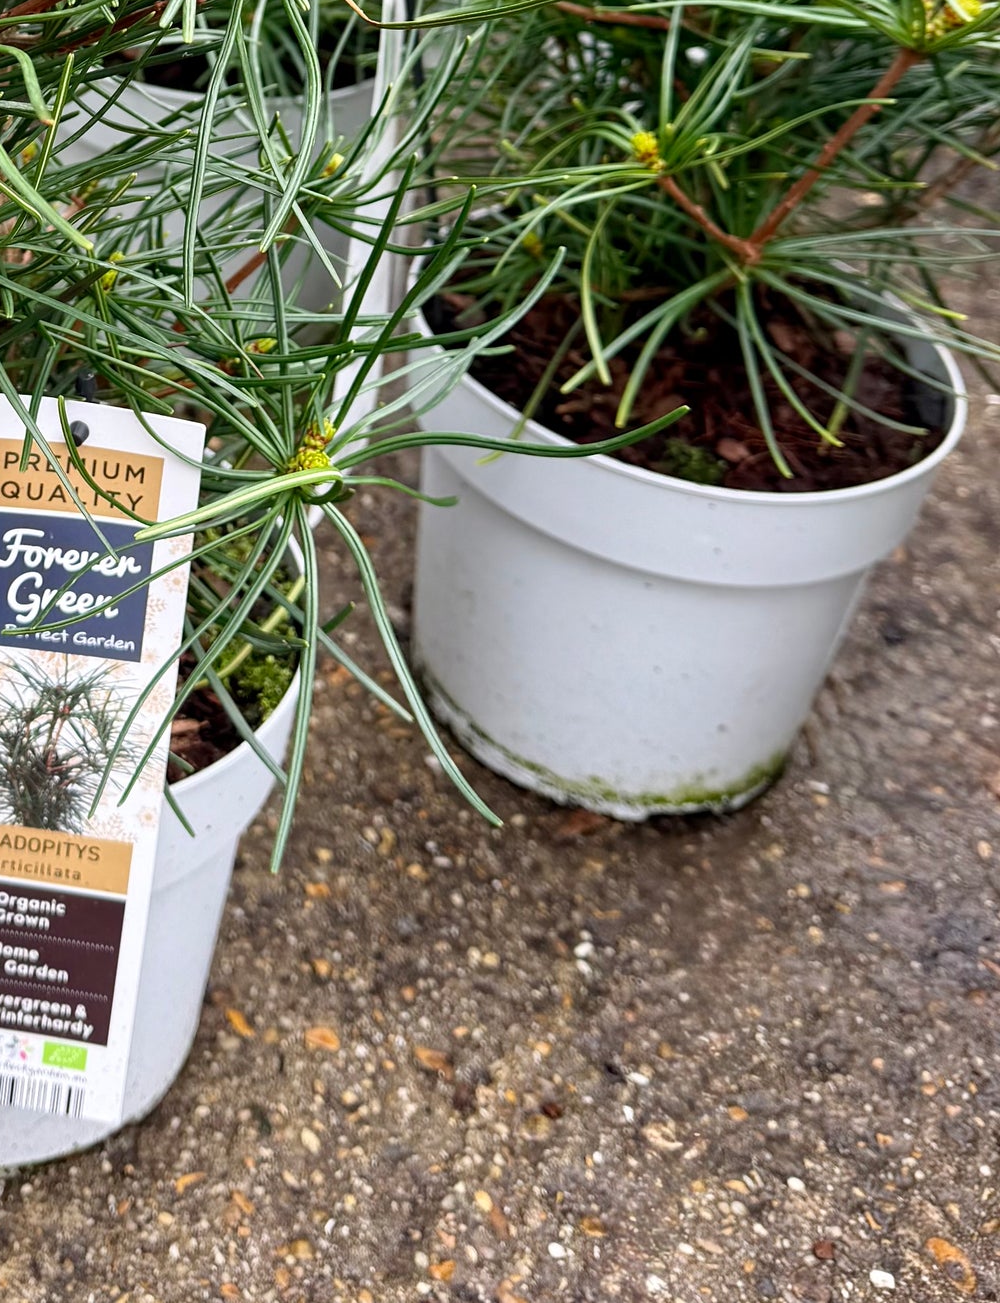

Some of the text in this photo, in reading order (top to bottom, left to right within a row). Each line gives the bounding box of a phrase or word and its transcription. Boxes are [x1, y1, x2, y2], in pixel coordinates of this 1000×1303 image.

[0, 480, 144, 511] QUALITY
[7, 571, 119, 624] Green
[73, 631, 135, 651] Garden
[4, 959, 69, 984] Garden
[74, 1003, 87, 1020] &
